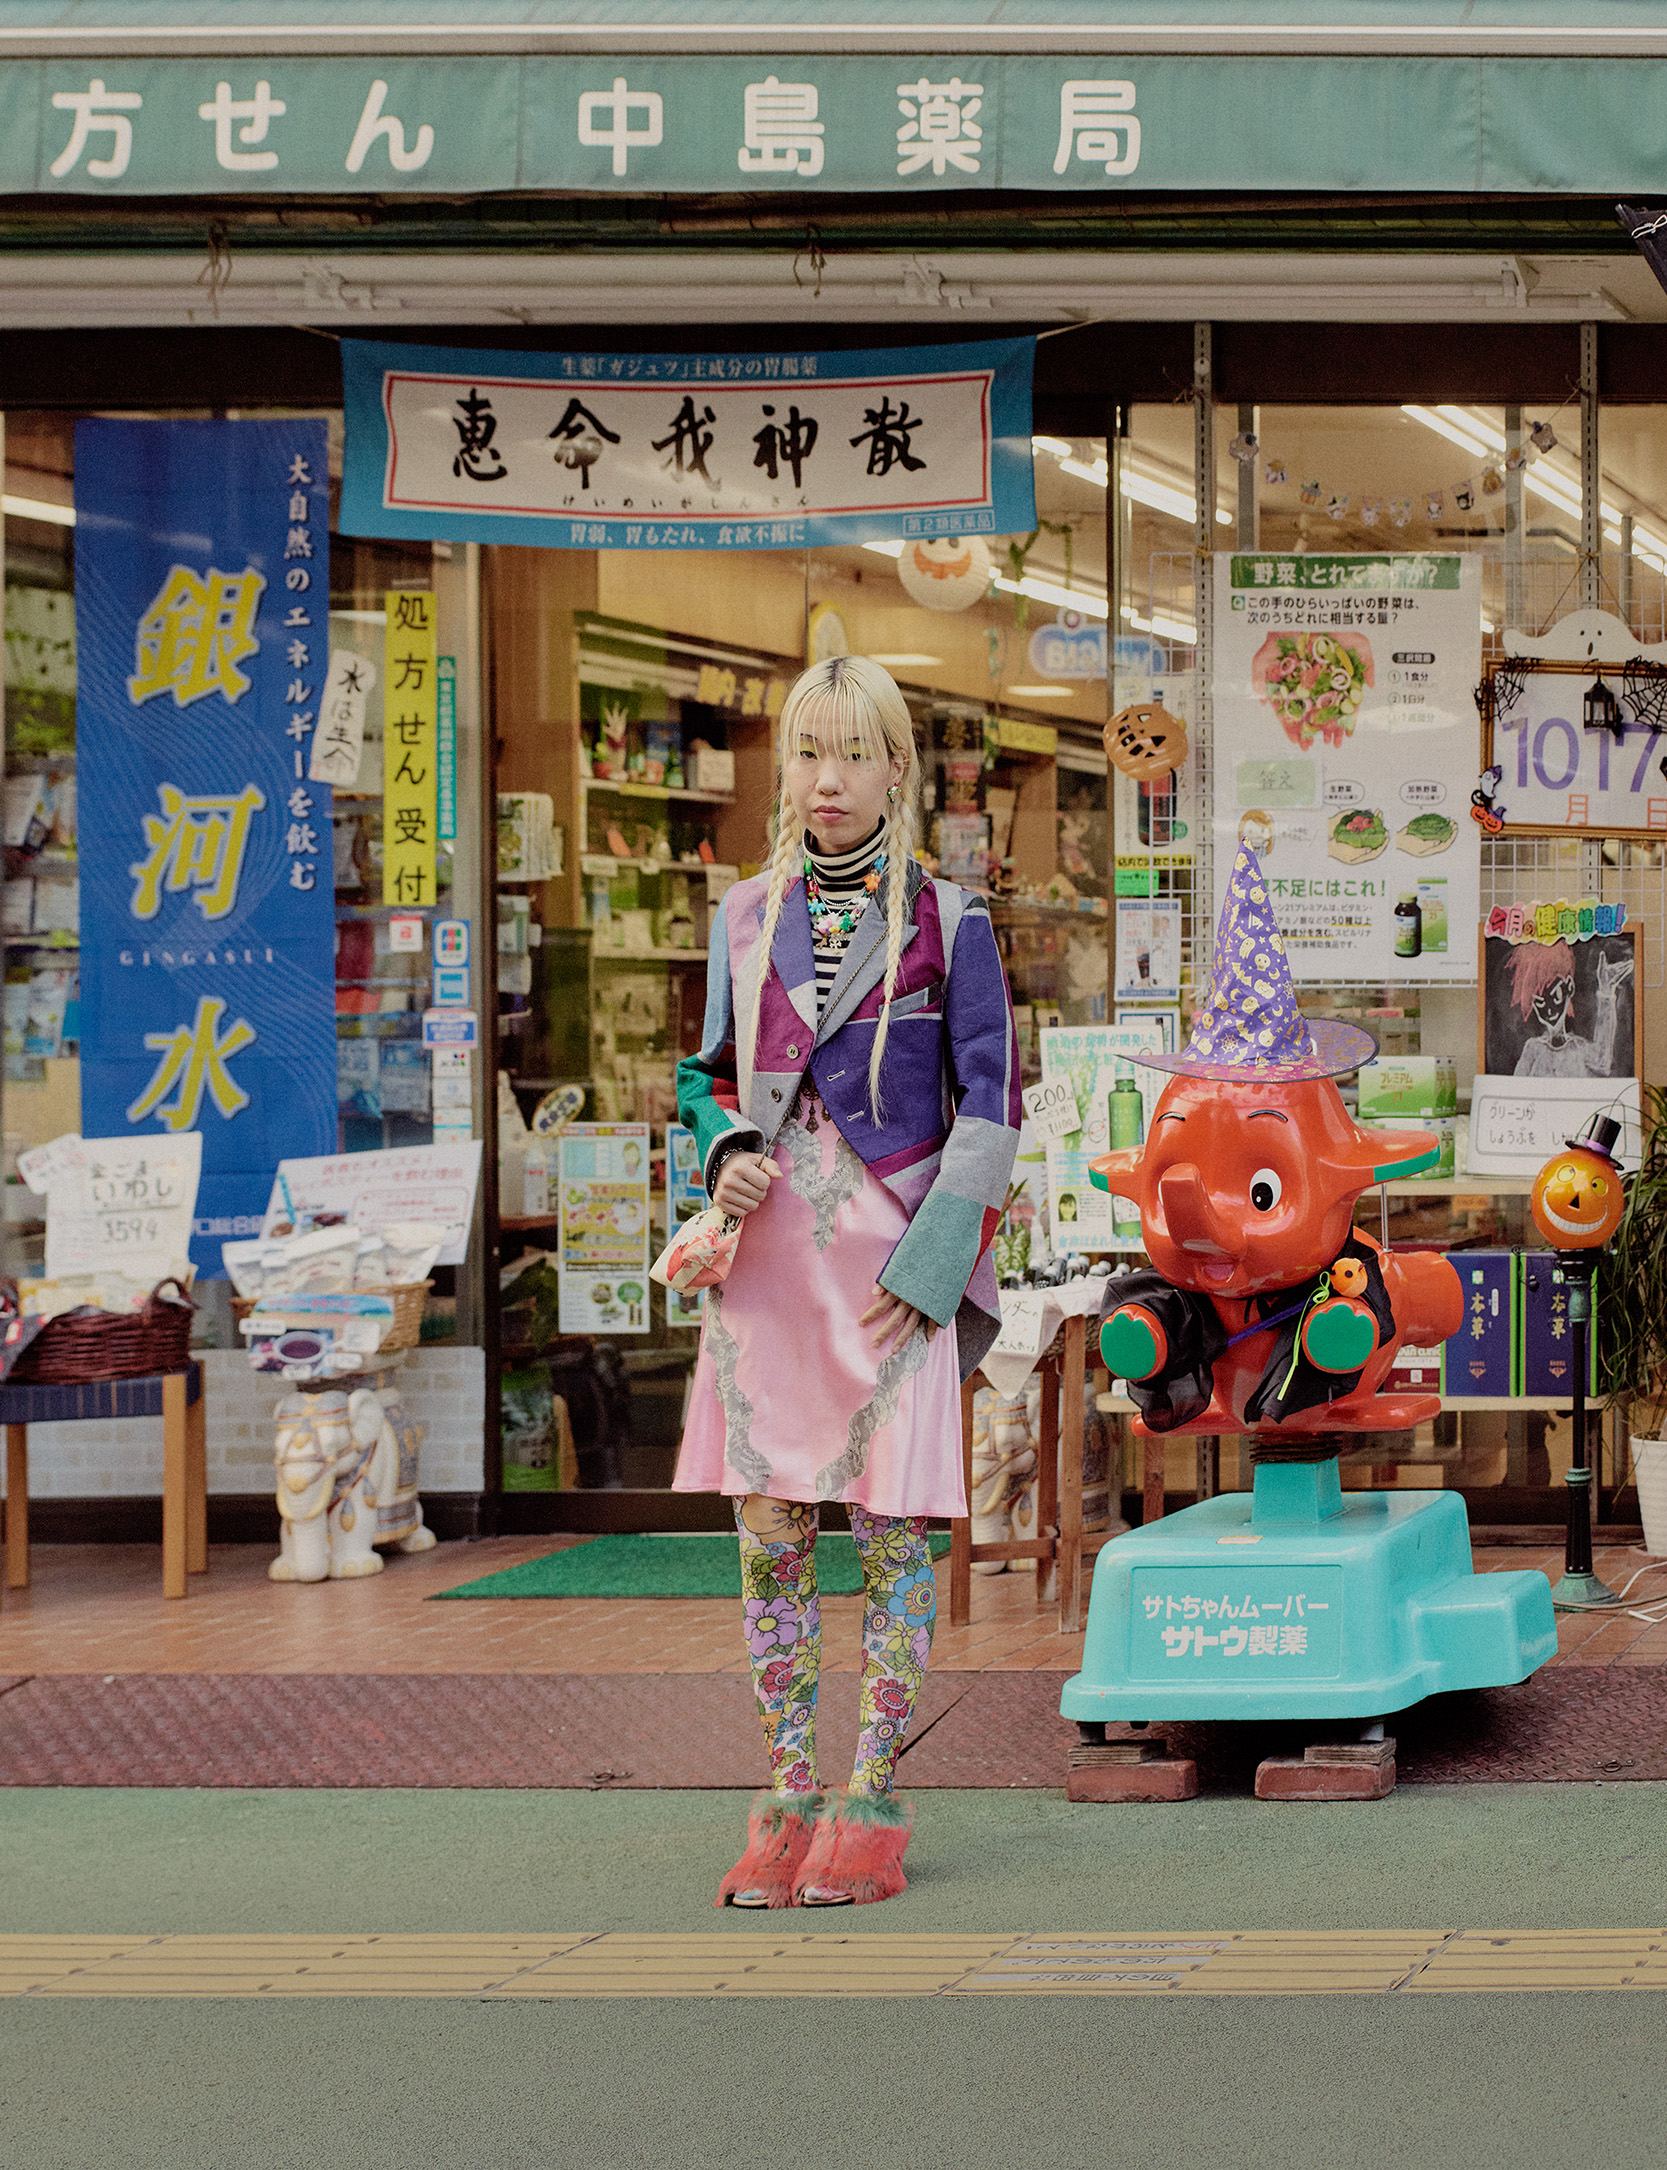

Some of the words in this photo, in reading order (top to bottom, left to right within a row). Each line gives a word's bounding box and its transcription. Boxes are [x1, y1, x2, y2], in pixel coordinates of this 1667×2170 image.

[51, 78, 434, 178] 方せん
[577, 76, 1142, 178] 中島薬局
[562, 355, 818, 378] 生薬「ガジュツ」主成分の胃腸薬
[452, 387, 927, 492] 恵命我神散
[570, 521, 806, 545] 胃弱、胃もたれ、食欲不振に
[284, 454, 319, 891] 大自然のエネルギーを飲む
[394, 595, 428, 903] 処方せん受付
[127, 563, 268, 1131] 銀河水
[1489, 1102, 1536, 1121] グリーンが
[1489, 1127, 1537, 1147] しょうぶを
[1142, 1594, 1330, 1620] サトちゃんムーバー
[1160, 1624, 1309, 1657] サトウ製薬
